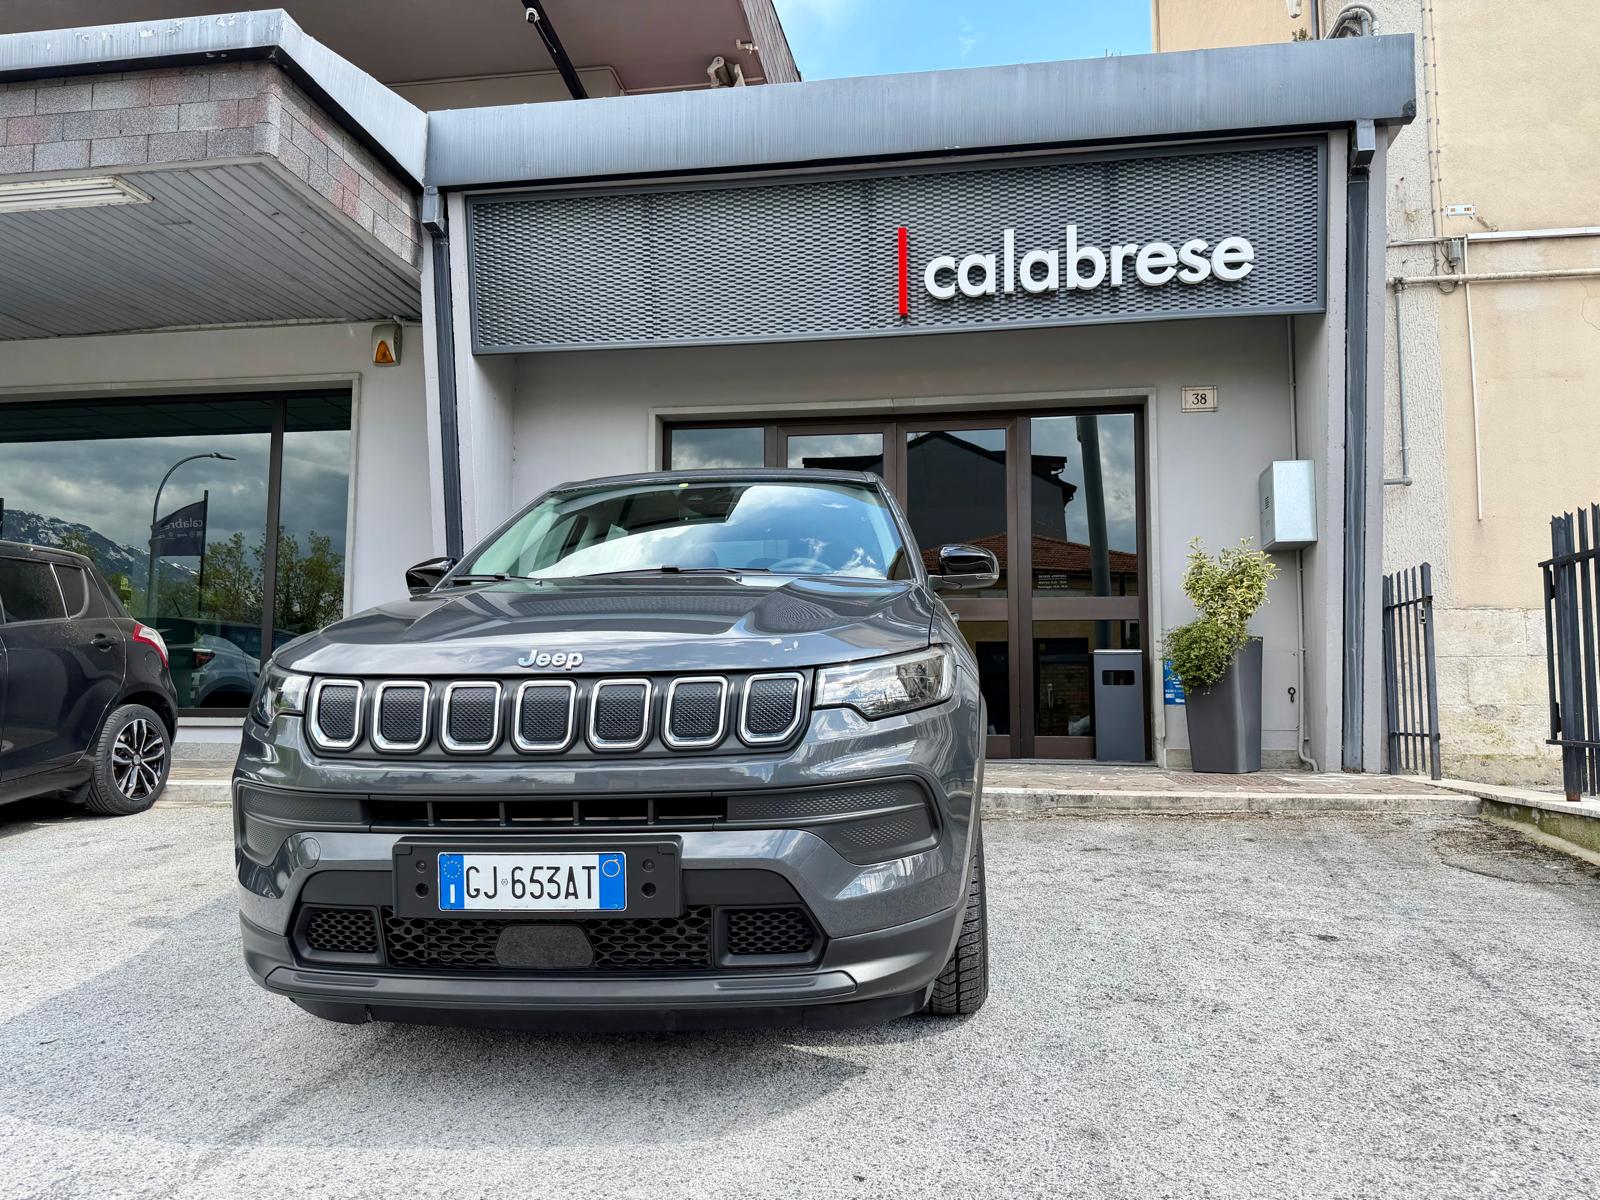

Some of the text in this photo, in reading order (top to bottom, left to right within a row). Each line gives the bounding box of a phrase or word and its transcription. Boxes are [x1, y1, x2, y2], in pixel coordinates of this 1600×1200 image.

[924, 224, 1255, 300] calabrese
[1191, 393, 1207, 405] 38
[518, 649, 583, 670] Jeep
